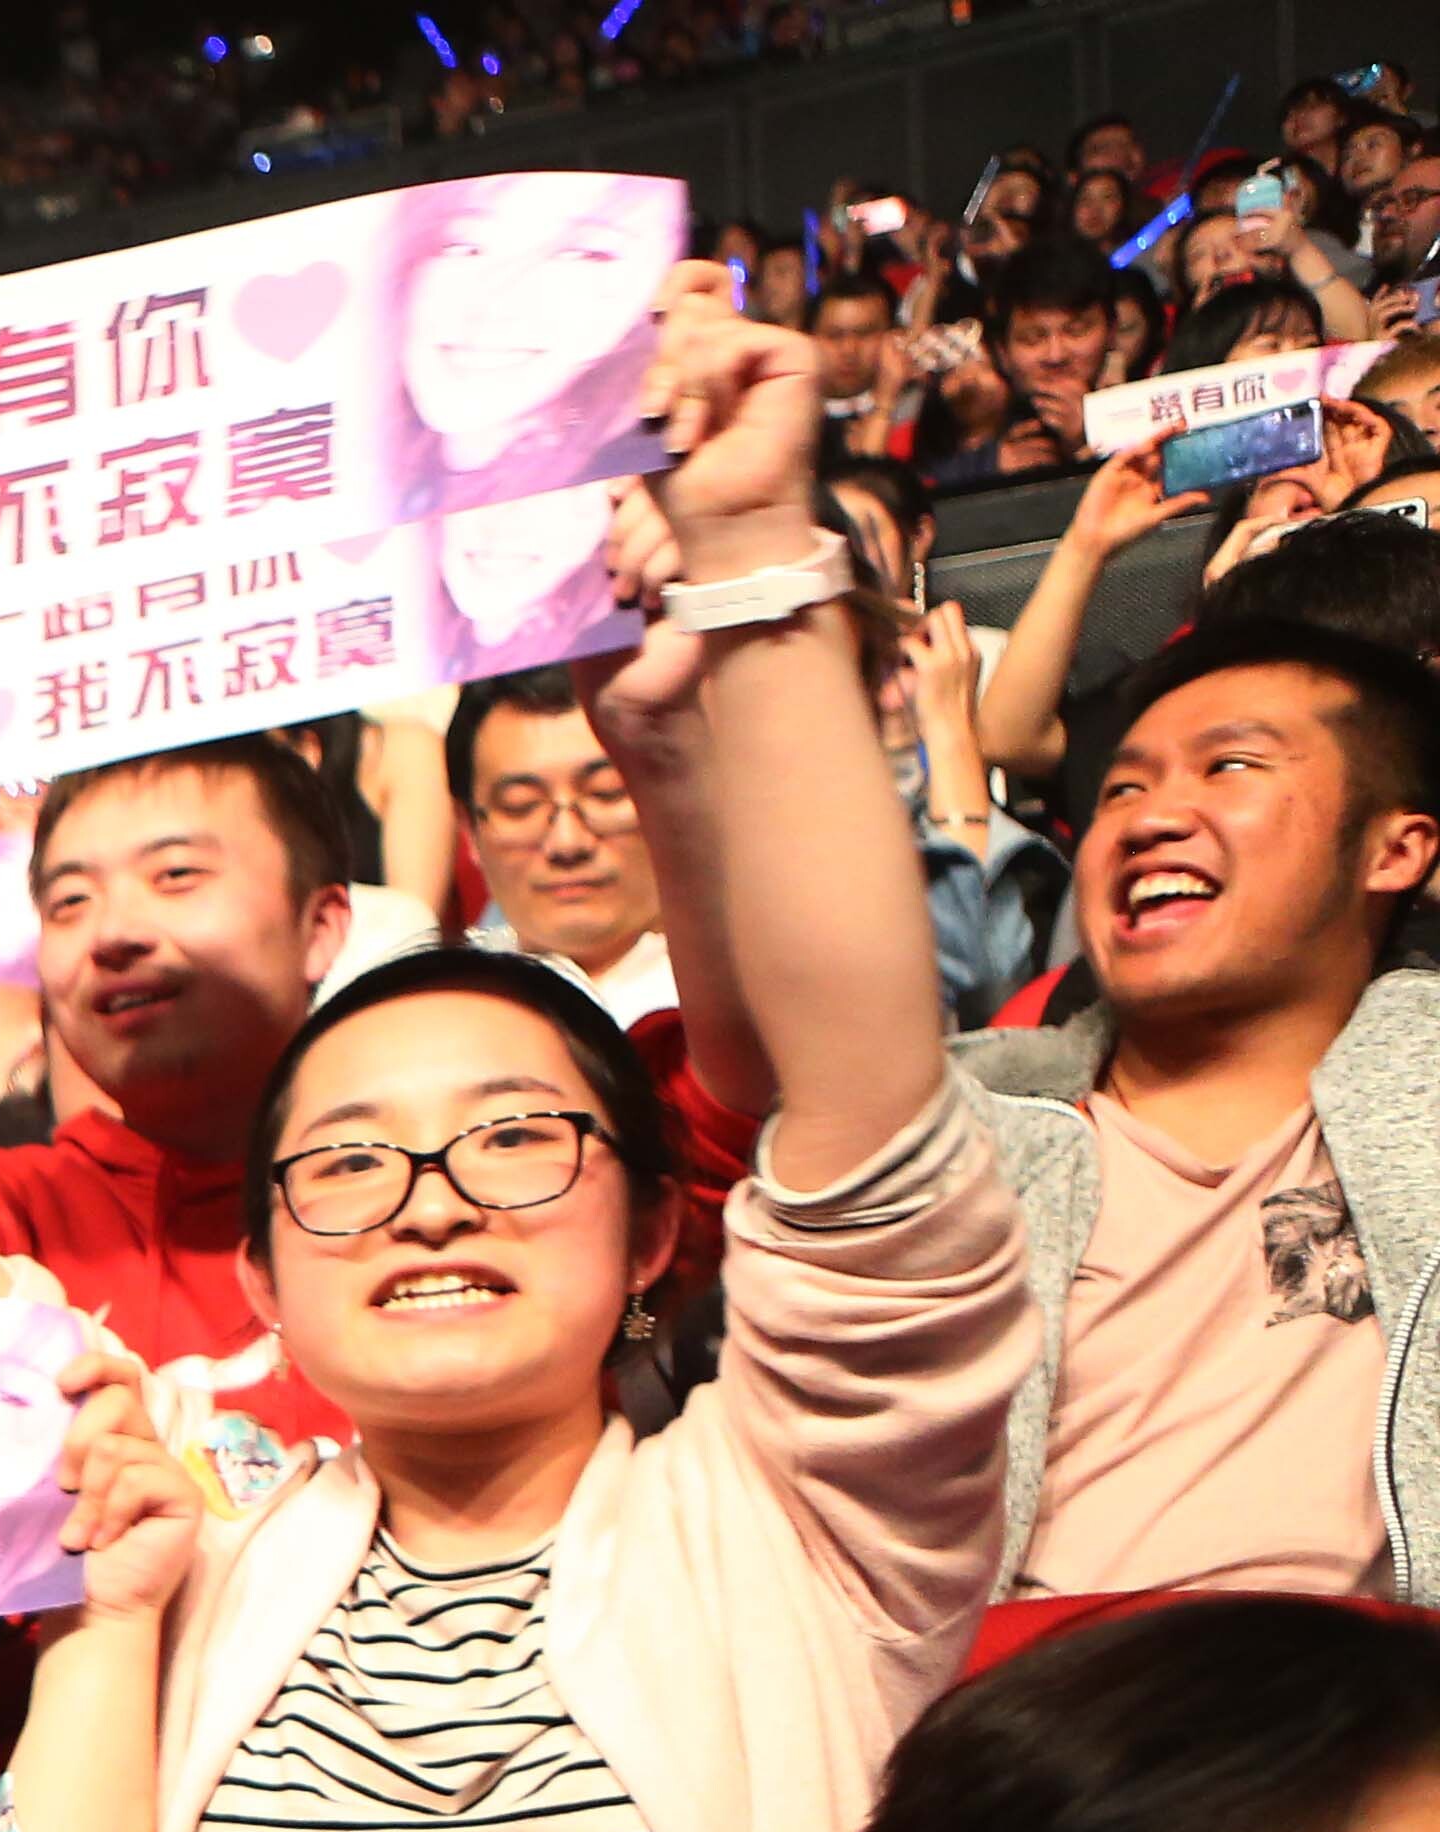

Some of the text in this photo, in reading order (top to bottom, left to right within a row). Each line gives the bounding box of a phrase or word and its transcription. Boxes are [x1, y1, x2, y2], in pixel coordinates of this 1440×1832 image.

[1108, 372, 1268, 424] 一路有你
[34, 594, 397, 740] 我不寂寞
